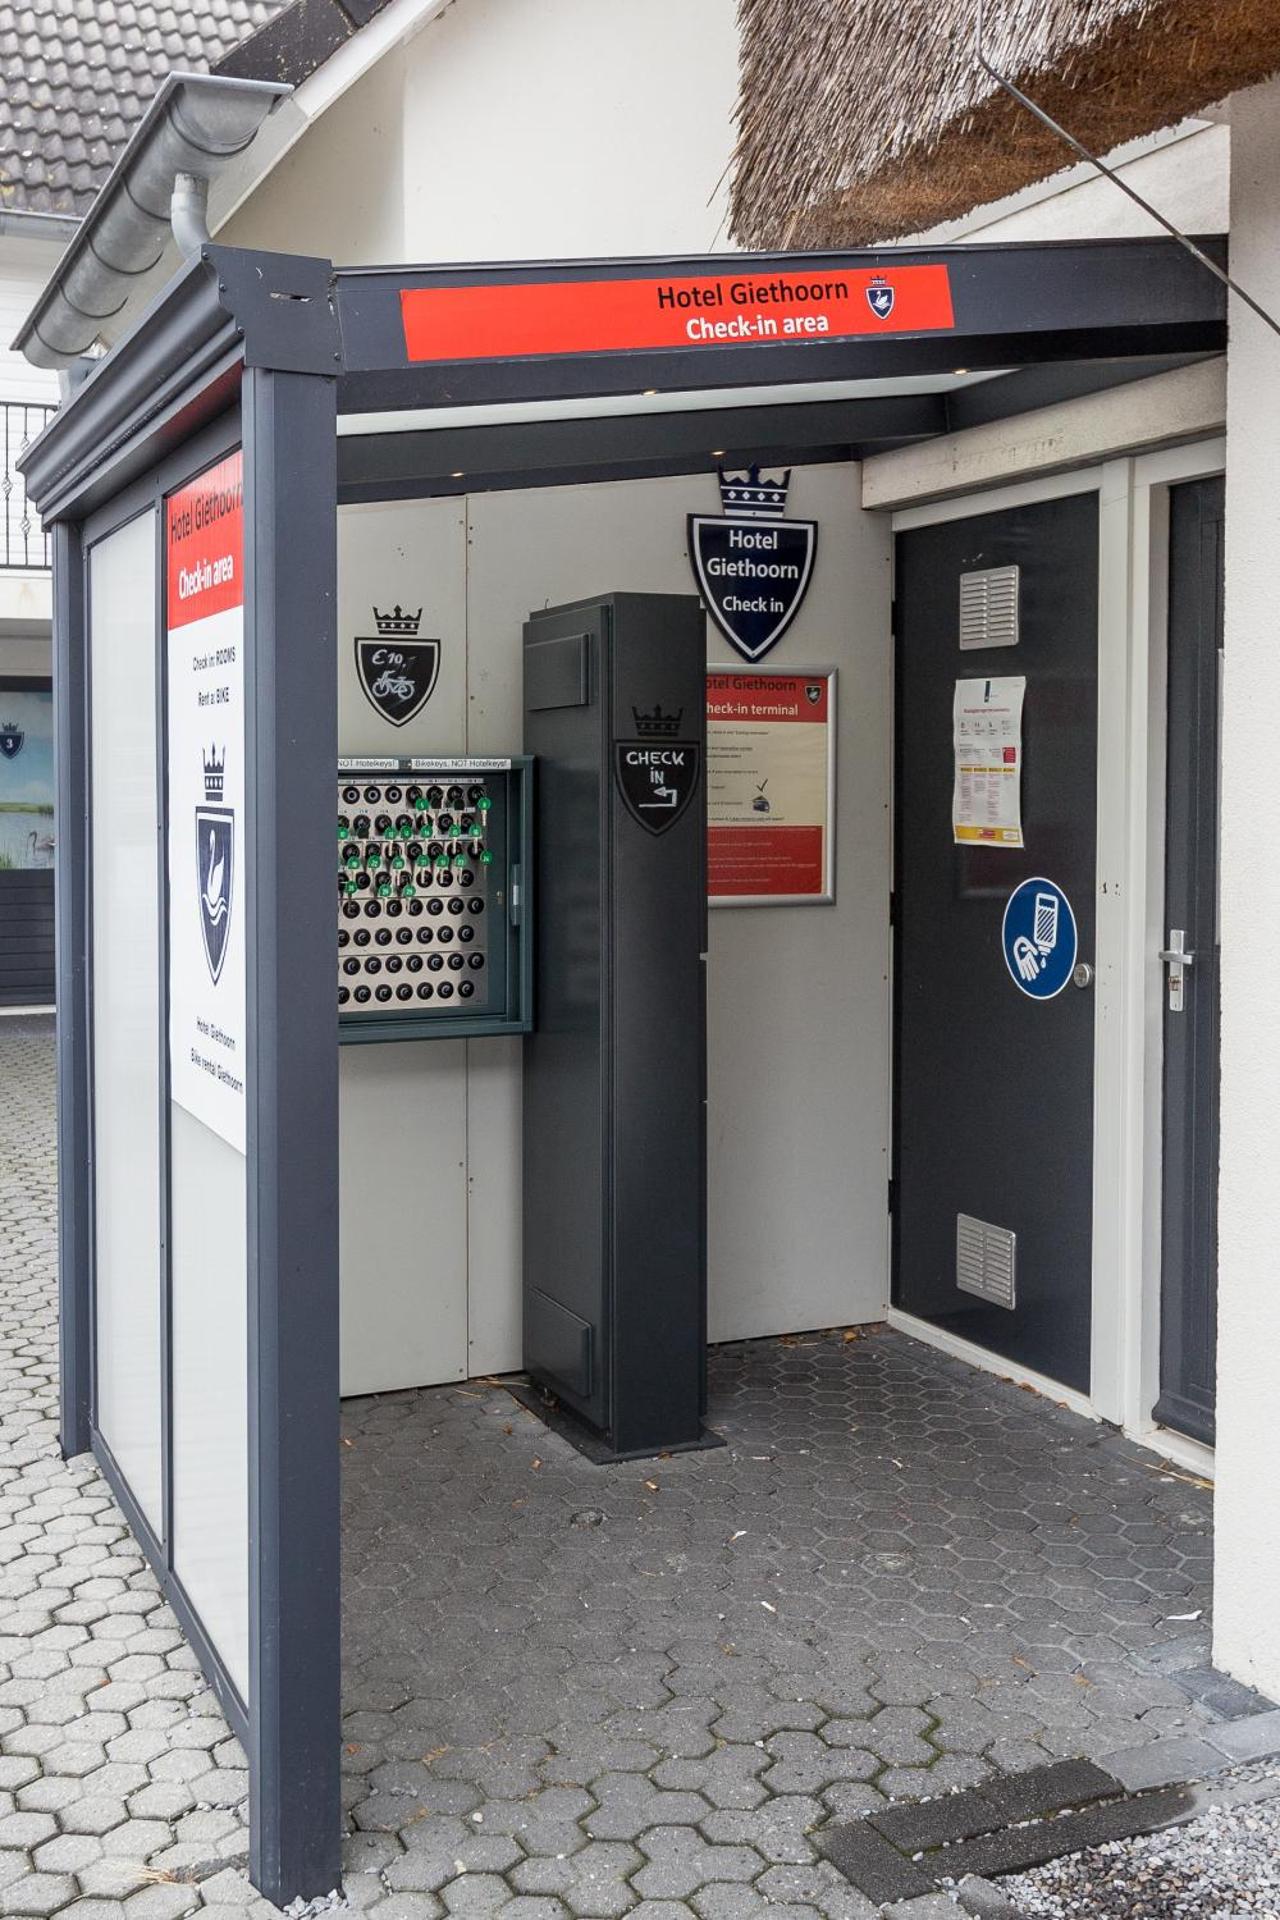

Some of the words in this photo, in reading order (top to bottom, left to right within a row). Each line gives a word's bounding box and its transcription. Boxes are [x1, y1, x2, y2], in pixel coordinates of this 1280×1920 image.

[658, 283, 723, 309] Hotel
[730, 279, 848, 305] Giethoorn
[686, 314, 777, 340] Check-in
[783, 314, 829, 333] area
[170, 500, 193, 545] Hotel
[195, 483, 244, 531] Giethoorn
[729, 529, 778, 550] Hotel
[179, 558, 212, 601] Check-in
[213, 554, 234, 586] area
[707, 557, 799, 579] Giethoorn
[722, 596, 767, 612] Check
[770, 597, 784, 612] in
[192, 653, 208, 671] Check
[216, 646, 236, 666] ROOMS
[706, 678, 729, 690] otel
[734, 678, 797, 692] Giethoorn
[216, 686, 230, 704] BIKE
[706, 701, 748, 715] heck-in
[751, 703, 799, 716] terminal
[6, 738, 13, 749] 3
[451, 760, 467, 768] NOT
[626, 750, 685, 766] CHECK
